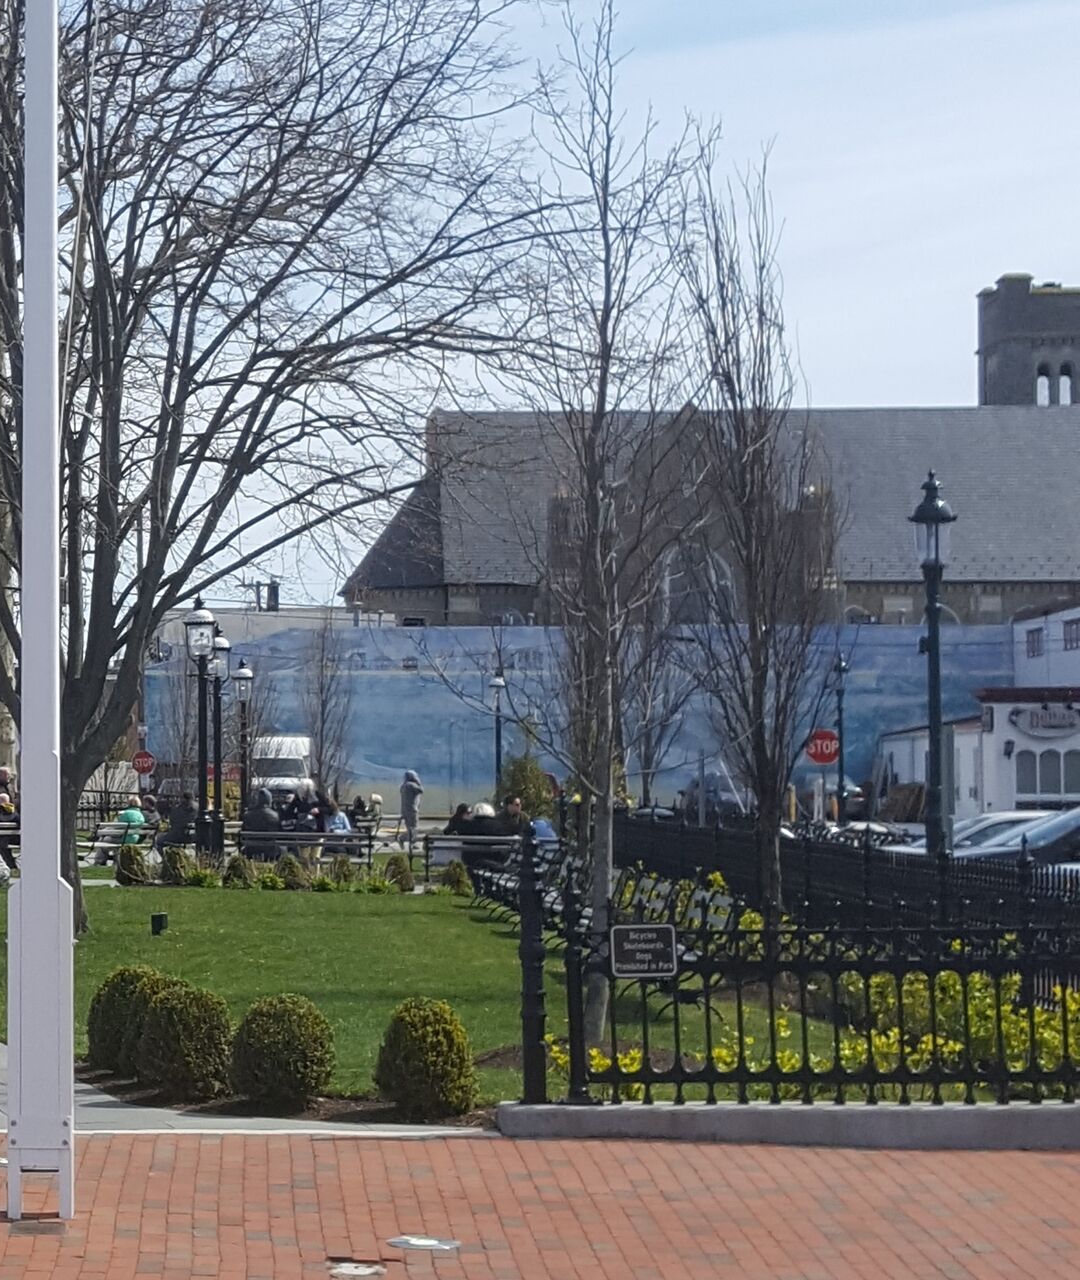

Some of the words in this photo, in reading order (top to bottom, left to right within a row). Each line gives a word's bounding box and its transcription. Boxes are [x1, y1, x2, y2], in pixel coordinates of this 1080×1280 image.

[809, 740, 839, 754] STOP
[135, 758, 153, 767] STOP
[629, 931, 657, 940] Bicycles
[635, 952, 652, 961] Dogs
